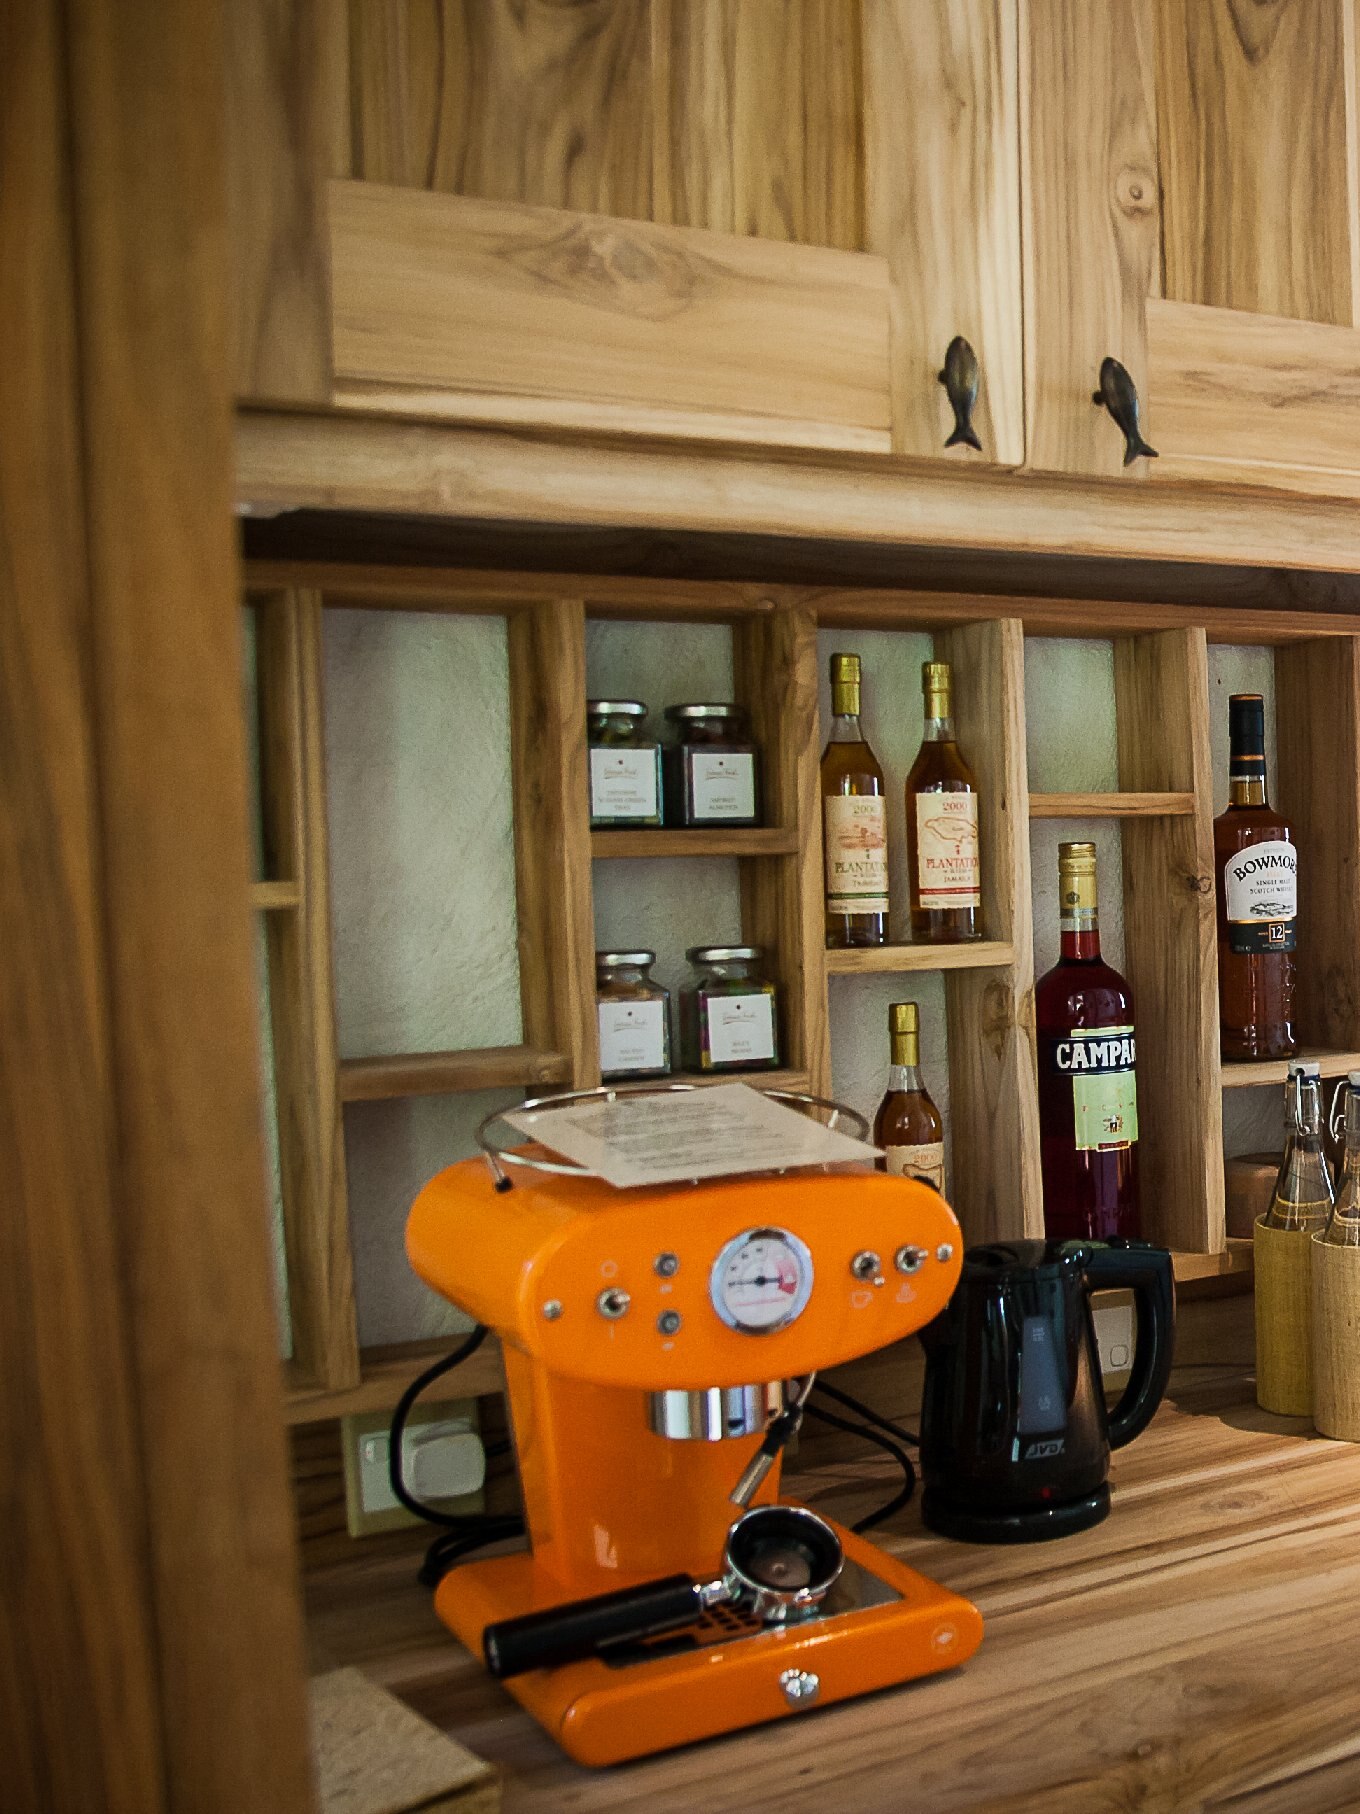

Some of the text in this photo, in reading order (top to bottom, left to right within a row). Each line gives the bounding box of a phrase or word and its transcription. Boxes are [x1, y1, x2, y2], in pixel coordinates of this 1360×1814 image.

[1232, 854, 1297, 882] BOWMOR
[1249, 886, 1275, 895] SCOTCH
[1270, 925, 1283, 939] 12
